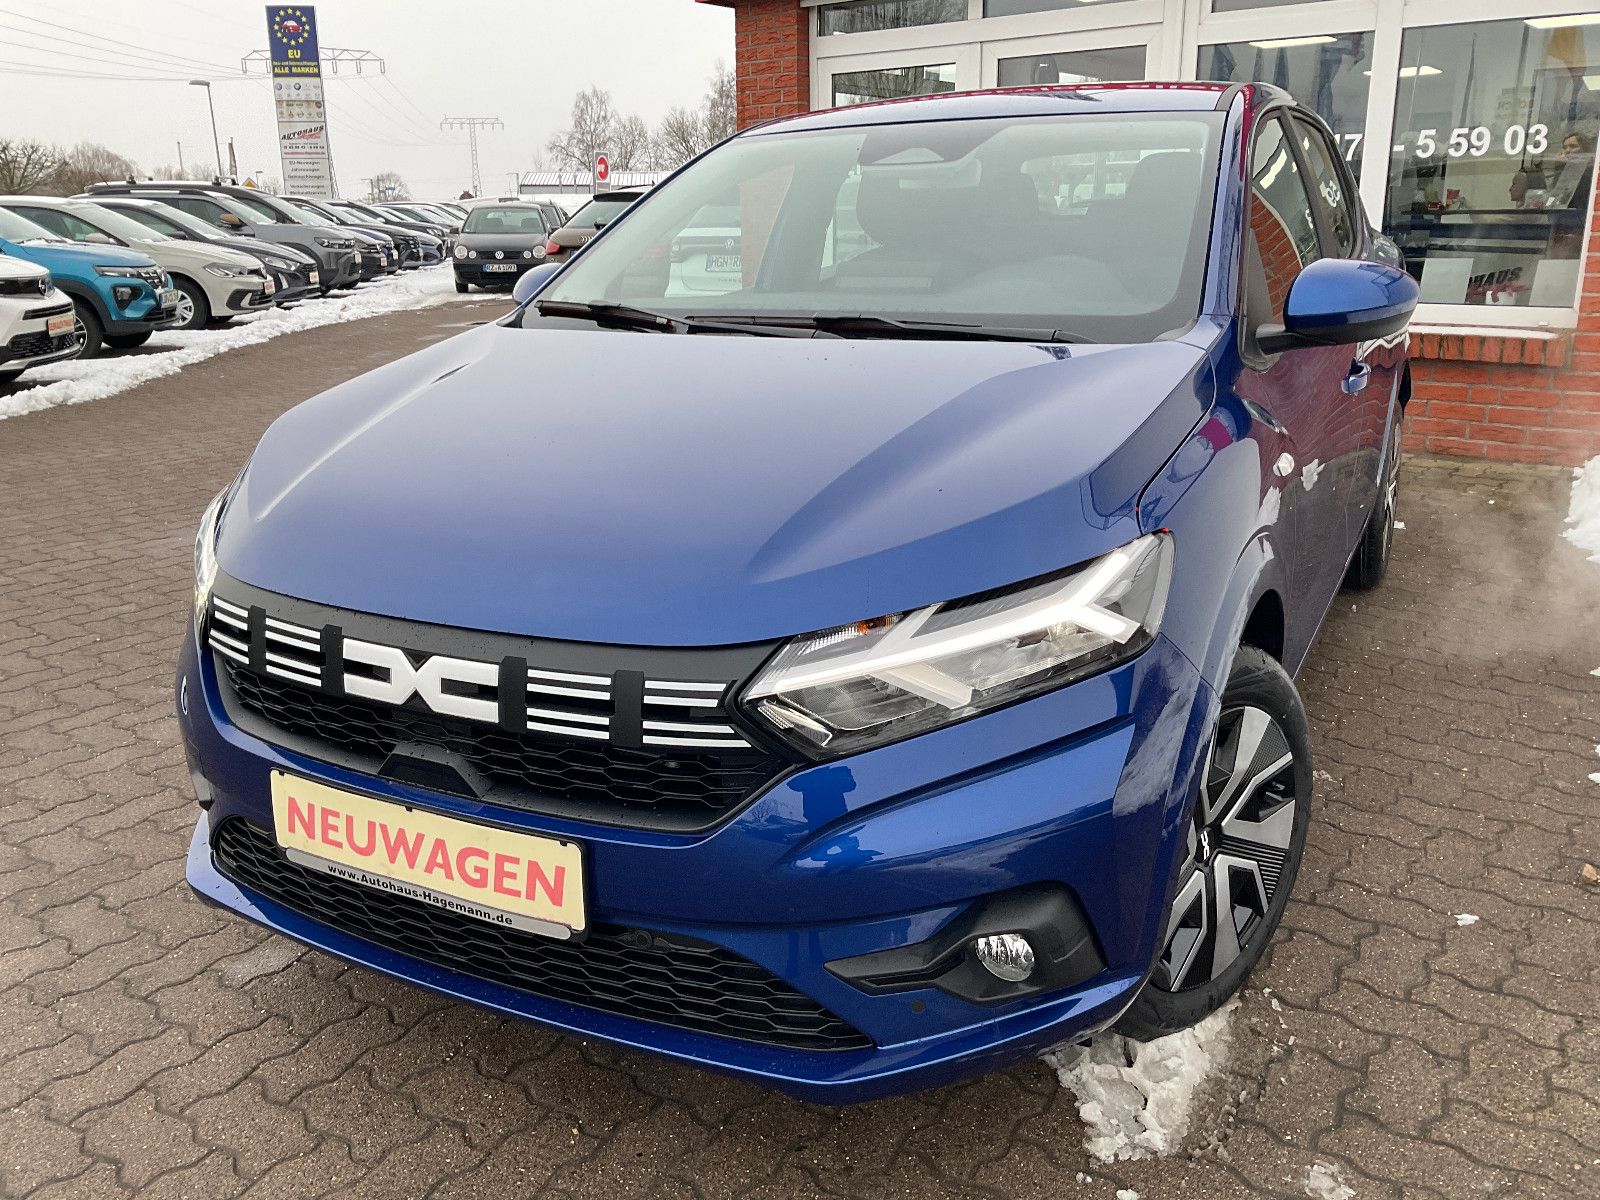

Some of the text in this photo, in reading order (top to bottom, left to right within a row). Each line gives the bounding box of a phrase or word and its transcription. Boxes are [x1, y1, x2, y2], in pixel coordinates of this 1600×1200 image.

[287, 49, 301, 59] EU
[274, 66, 319, 74] ALLE MARKEN
[281, 125, 325, 141] AUTOHAUS
[1416, 128, 1437, 159] 5
[1448, 126, 1491, 158] 59
[1504, 123, 1549, 156] 03
[287, 796, 566, 908] NEUWAGEN
[327, 863, 513, 926] www.Autohaus-Hagemann.de
